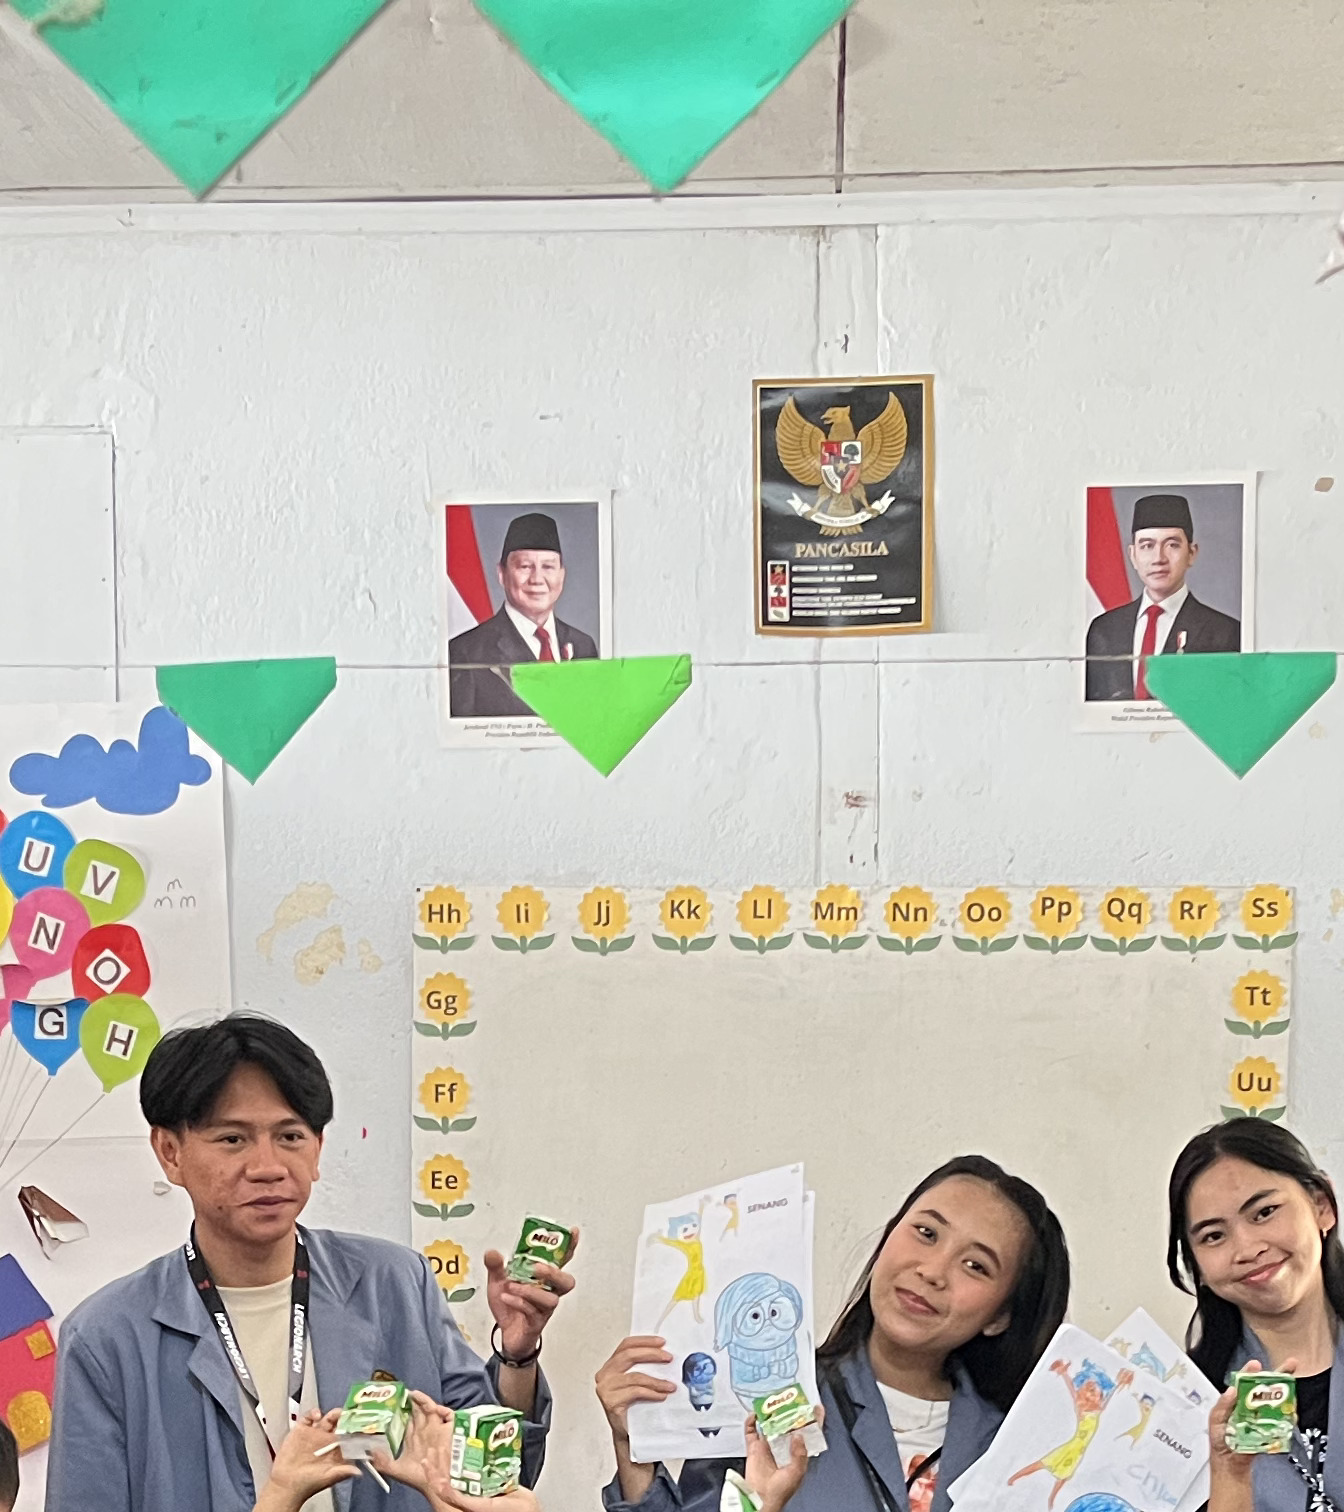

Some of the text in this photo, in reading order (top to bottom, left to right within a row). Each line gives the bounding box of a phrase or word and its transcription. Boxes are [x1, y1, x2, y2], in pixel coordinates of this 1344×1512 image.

[795, 540, 889, 558] PANCASILA
[24, 841, 50, 872] U
[92, 865, 116, 895] V
[428, 897, 1278, 927] Hh Ii Jj Kk Ll Mm Nn Oo Pp Qq Rr Ss
[32, 917, 60, 950] N
[93, 957, 121, 985] O
[427, 991, 457, 1015] Gg
[1245, 986, 1271, 1006] Tt
[39, 1008, 64, 1036] G
[106, 1024, 133, 1056] H
[1238, 1073, 1271, 1092] Uu
[435, 1083, 457, 1103] Ff
[432, 1171, 457, 1189] Ee
[532, 1234, 558, 1245] MILO
[292, 1303, 305, 1374] LEGIONARCH
[361, 1390, 391, 1398] MILO
[1251, 1391, 1284, 1402] MILO
[1153, 1429, 1192, 1459] SENANG
